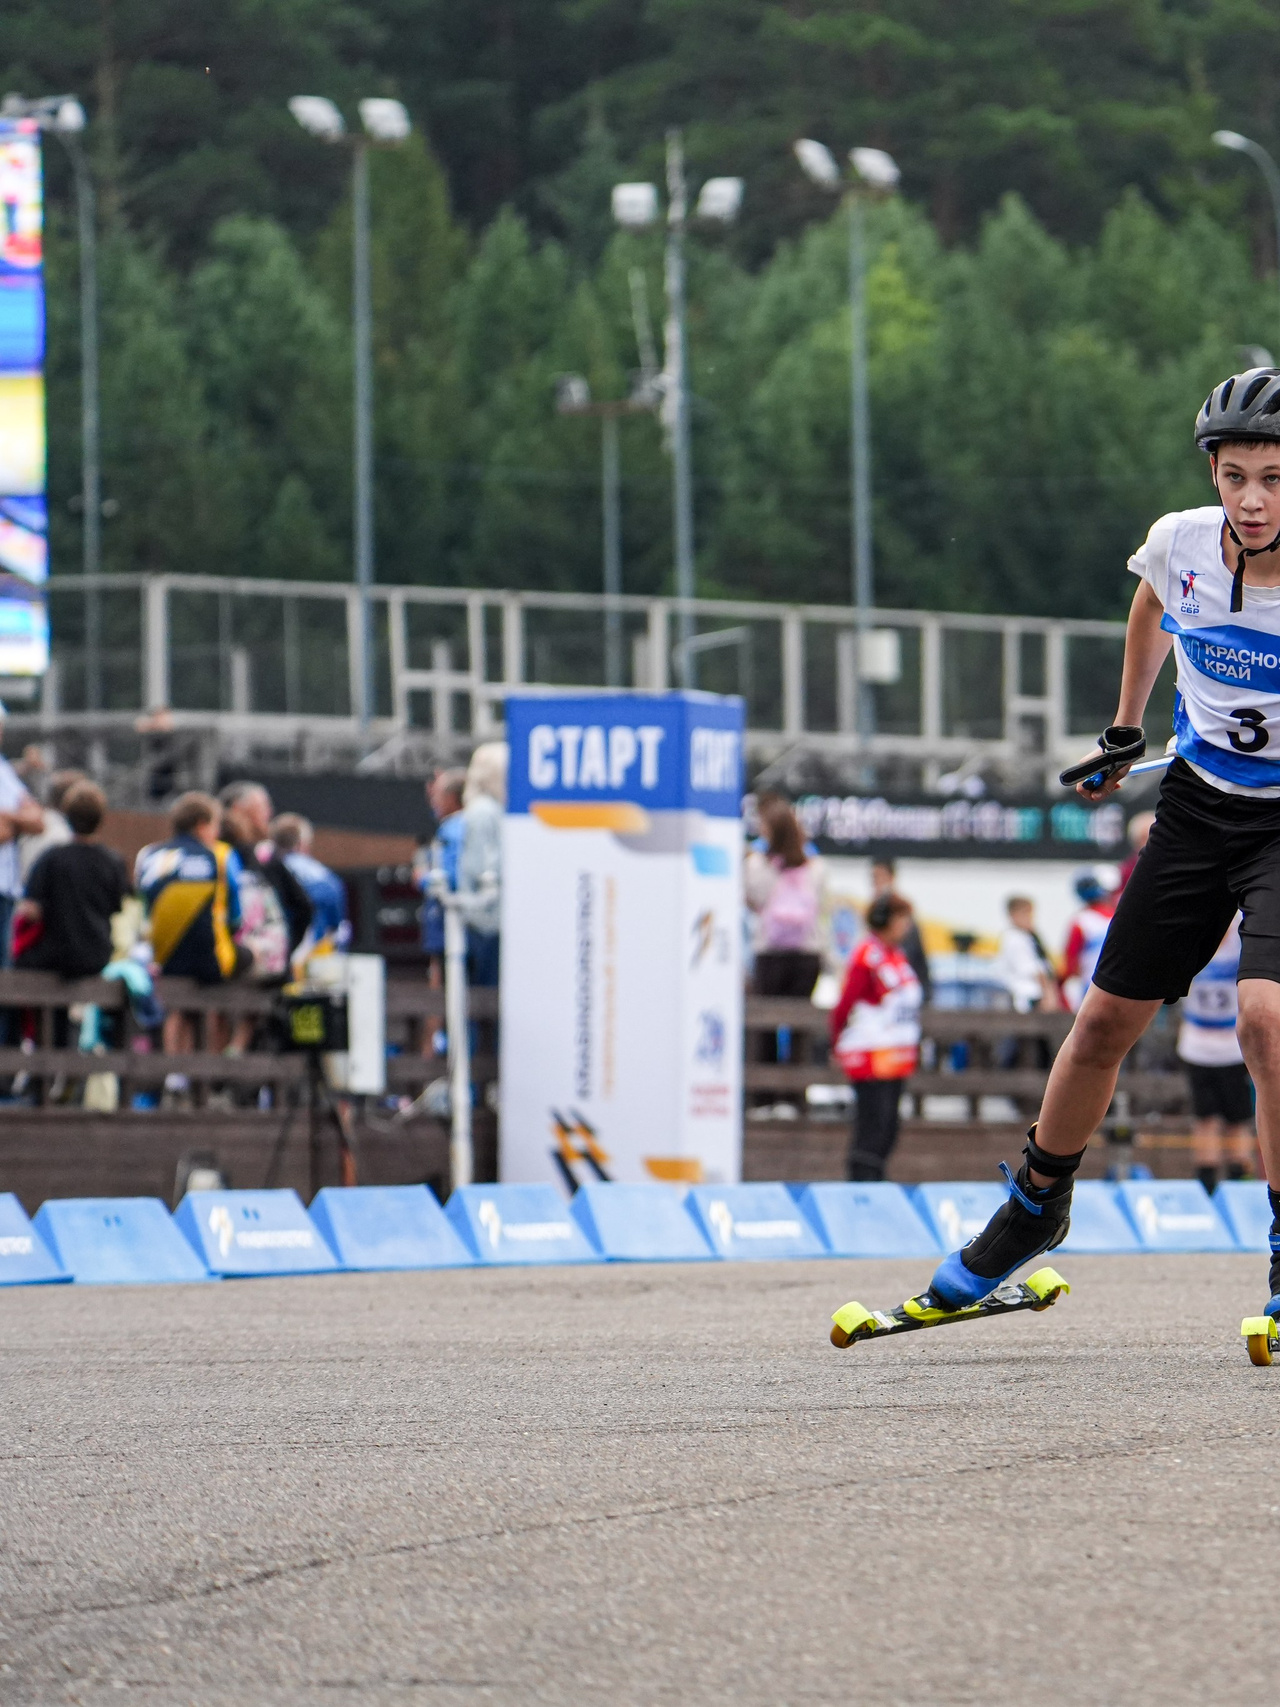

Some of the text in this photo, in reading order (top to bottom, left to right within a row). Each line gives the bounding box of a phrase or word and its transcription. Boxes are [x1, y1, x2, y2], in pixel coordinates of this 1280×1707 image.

[1181, 605, 1200, 615] СБР
[1204, 658, 1251, 681] КРАЙ
[1226, 708, 1270, 752] 3
[528, 723, 666, 790] СТАРТ
